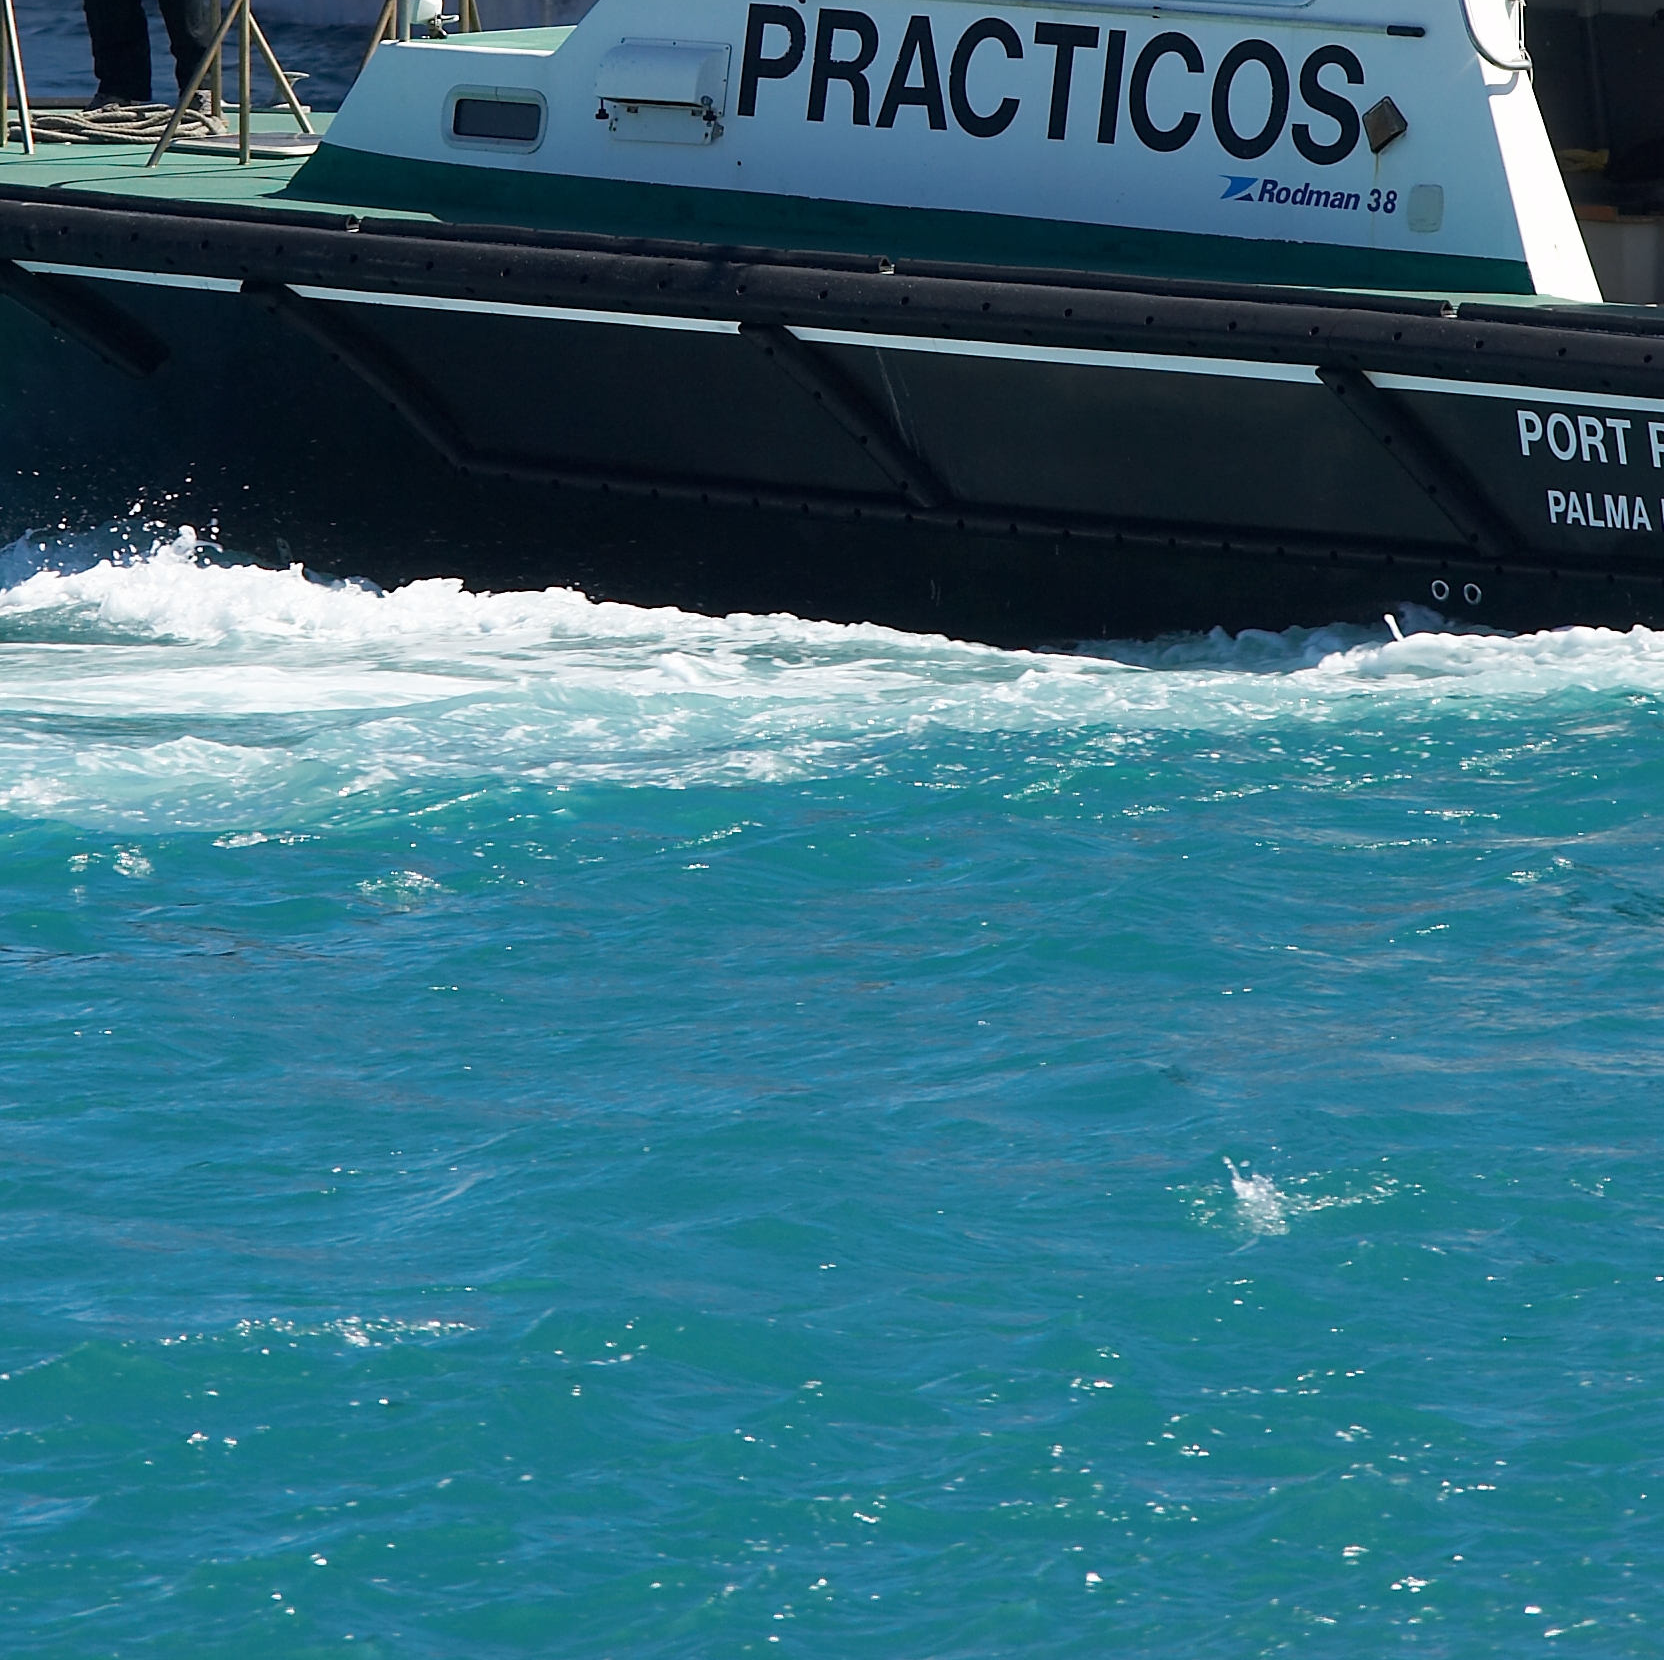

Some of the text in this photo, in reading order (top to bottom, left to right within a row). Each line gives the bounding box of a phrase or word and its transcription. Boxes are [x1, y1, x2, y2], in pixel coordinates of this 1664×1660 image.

[737, 2, 1366, 166] PRACTICOS
[1257, 178, 1399, 215] Rodman 38
[1516, 409, 1632, 466] PORT
[1546, 488, 1654, 533] PALMA
